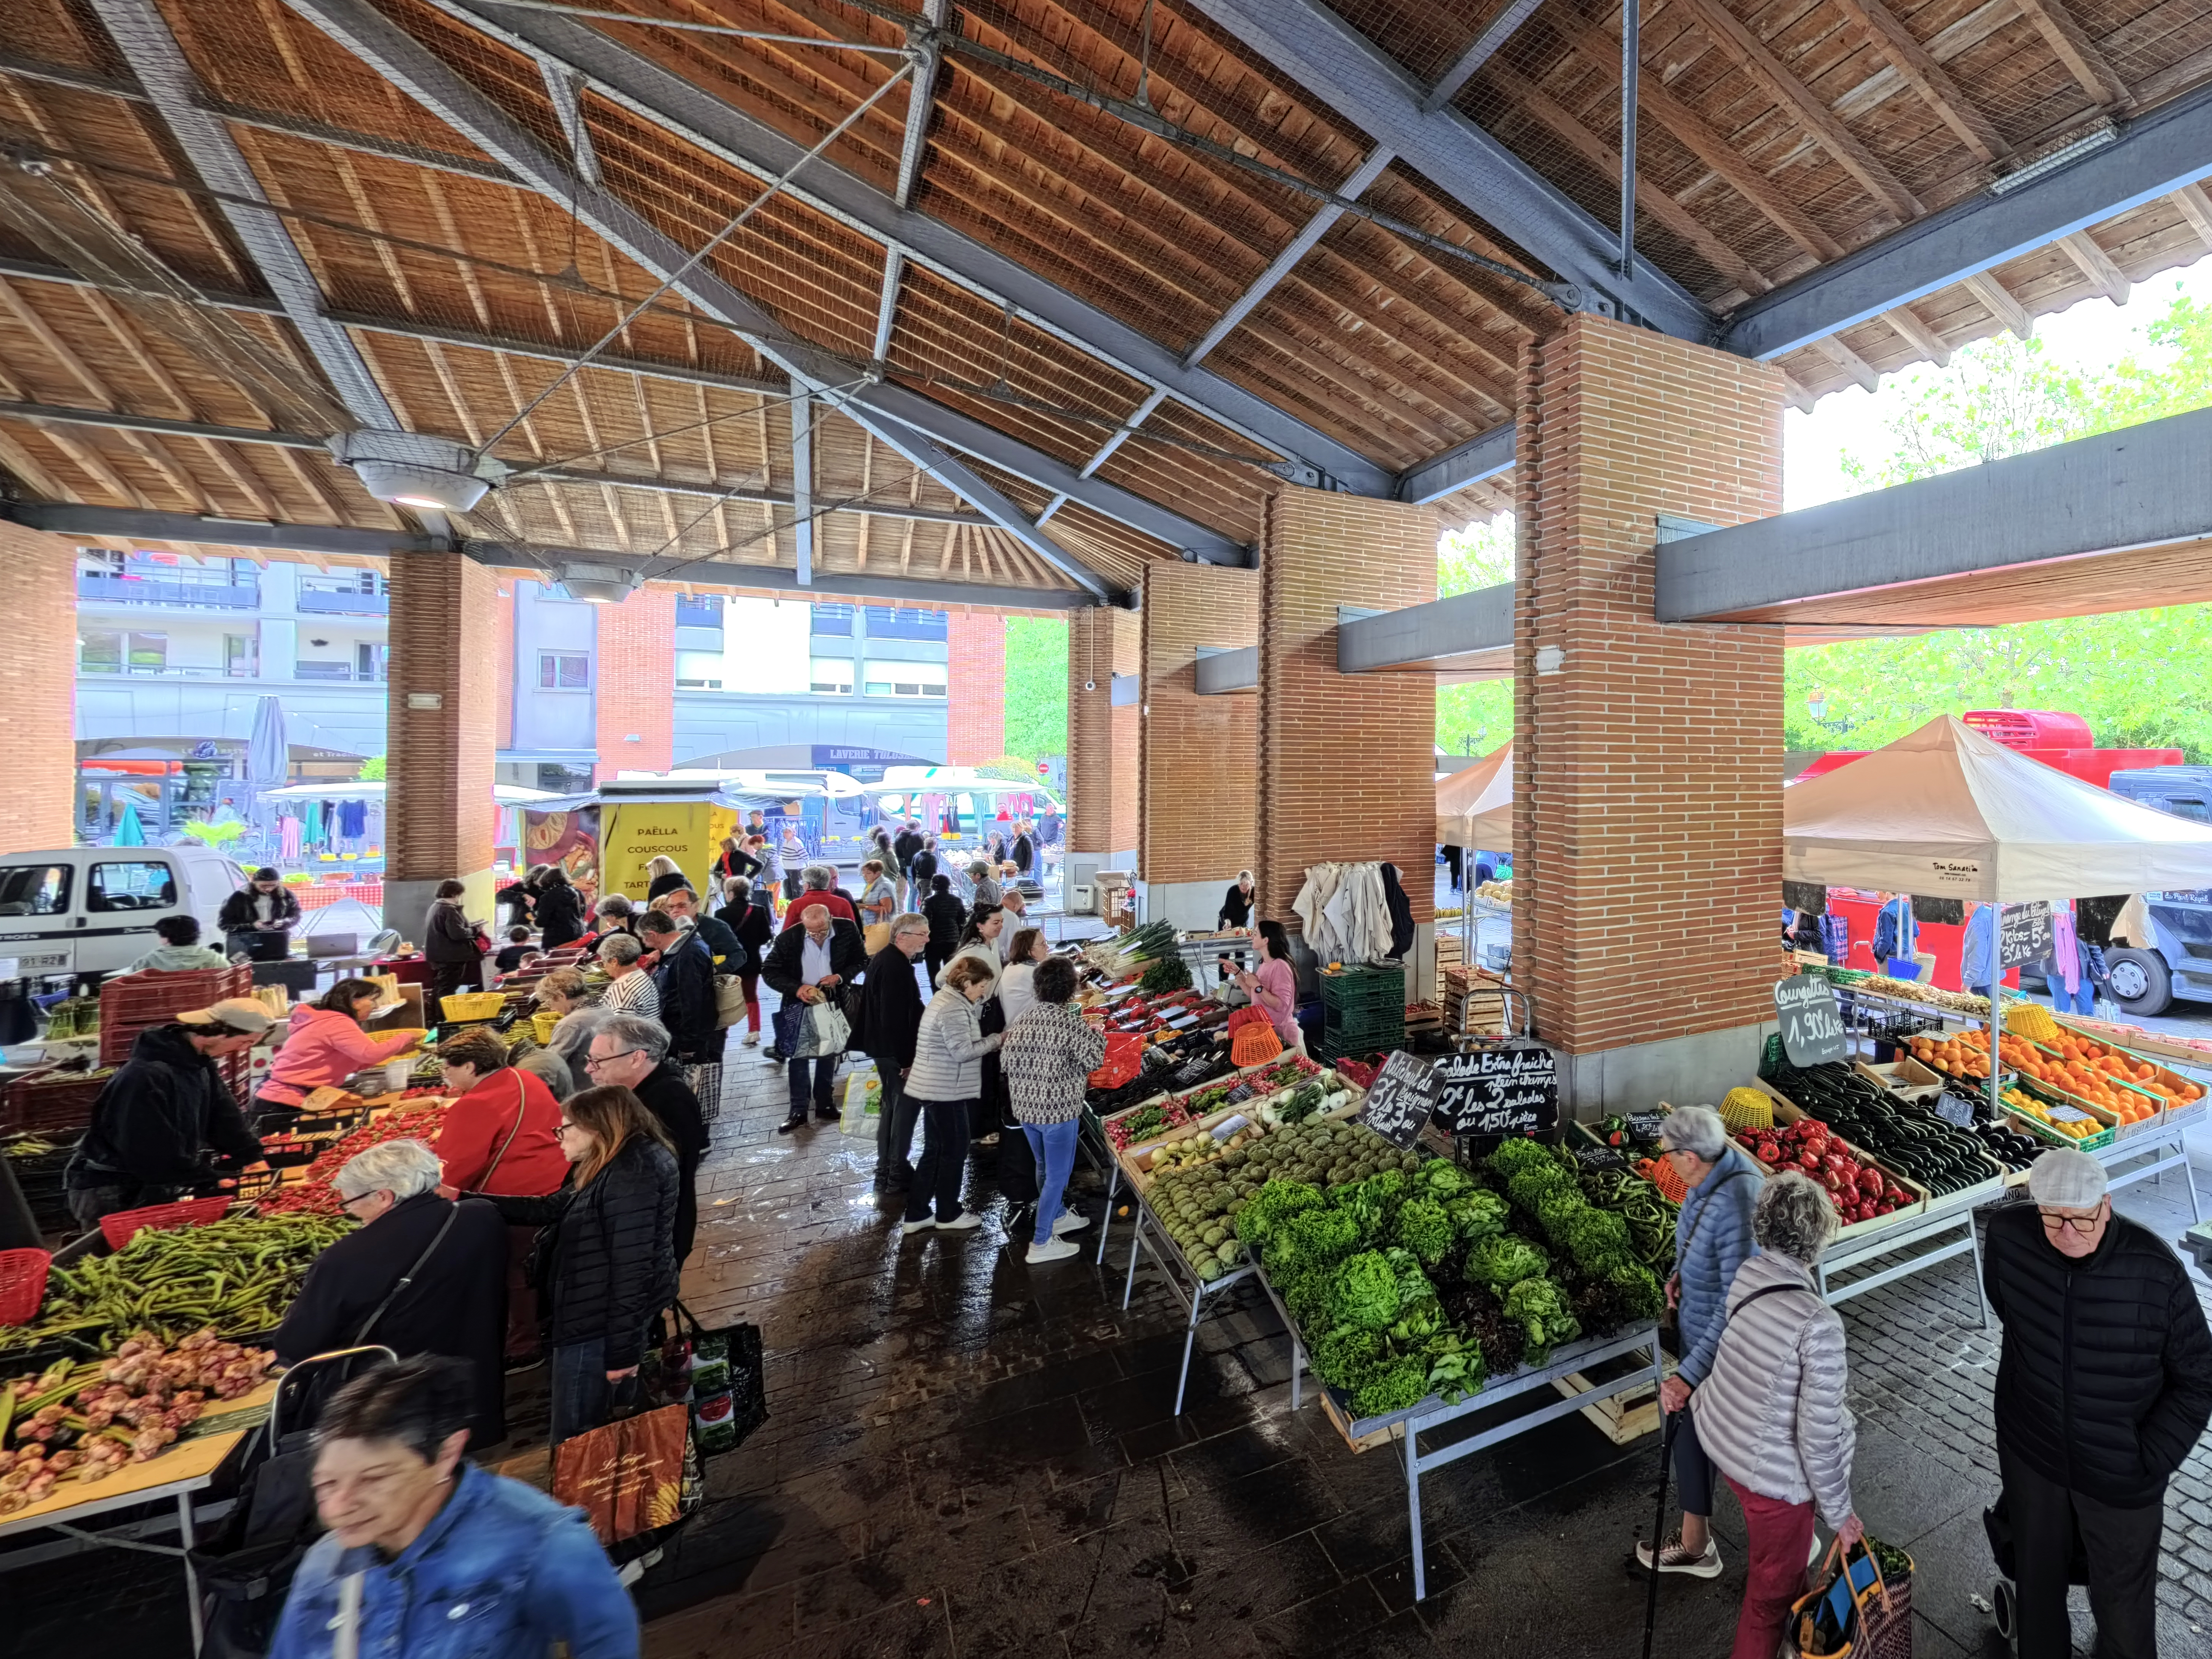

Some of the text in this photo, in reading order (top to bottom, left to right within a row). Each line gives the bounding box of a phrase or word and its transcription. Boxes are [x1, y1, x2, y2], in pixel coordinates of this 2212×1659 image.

[830, 749, 870, 759] LAVERIE
[638, 826, 678, 836] PAËLLA
[627, 845, 688, 853] COUSCOUS
[1948, 863, 1971, 872] Sanati
[1774, 974, 1830, 1009] Courgettes
[1433, 1055, 1479, 1078] Salade
[1480, 1053, 1512, 1073] Extra
[1417, 1069, 1433, 1092] de
[1484, 1073, 1557, 1092] plein champs
[1457, 1088, 1485, 1117] les
[1486, 1087, 1505, 1109] 2
[1503, 1090, 1545, 1108] salades
[1390, 1101, 1406, 1127] 3
[1401, 1119, 1416, 1131] ou
[1456, 1117, 1476, 1131] ou
